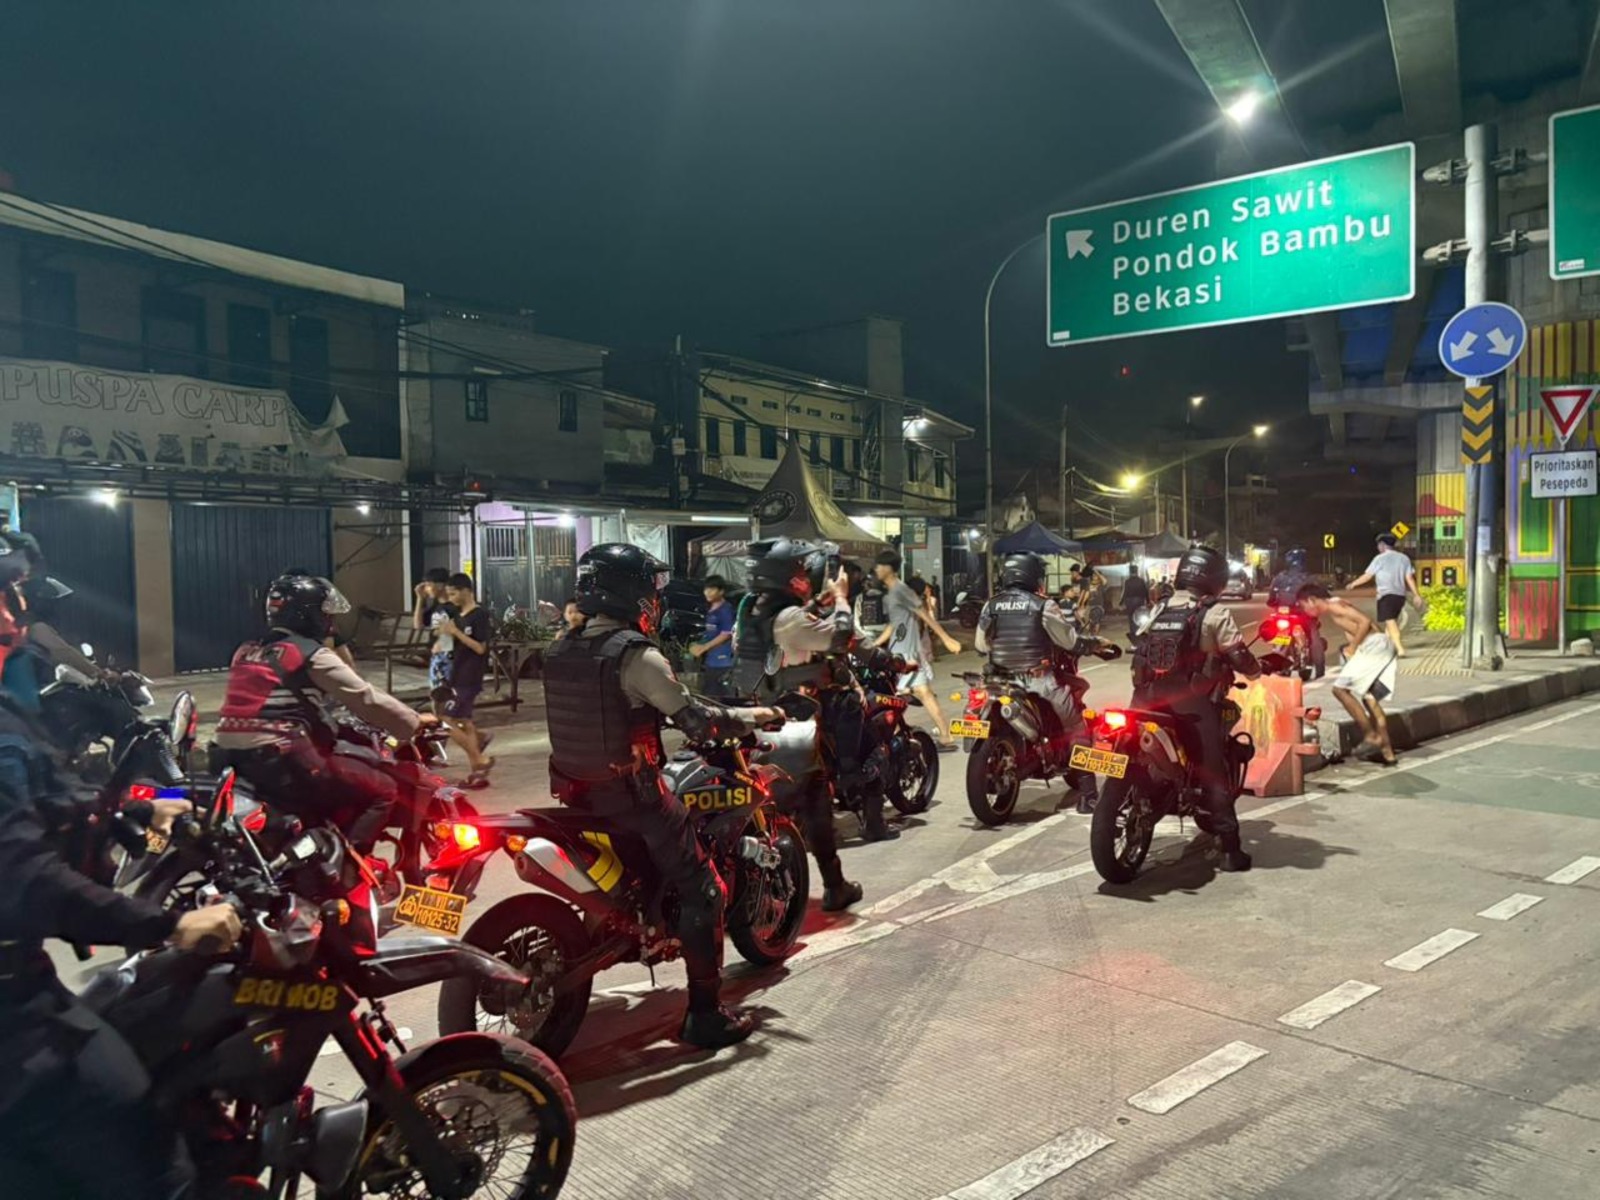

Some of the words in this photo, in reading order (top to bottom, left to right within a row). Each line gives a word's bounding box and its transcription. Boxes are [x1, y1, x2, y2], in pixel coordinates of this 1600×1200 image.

[1113, 207, 1210, 243] Duren
[1231, 180, 1333, 222] Sawit
[1113, 237, 1239, 279] Pondok
[1260, 214, 1391, 257] Bambu
[1113, 275, 1222, 316] Bekasi
[1, 364, 163, 415] PUSPA
[1534, 457, 1594, 472] Prioritaskan
[1541, 476, 1588, 491] Pesepeda
[683, 787, 752, 810] POLISI
